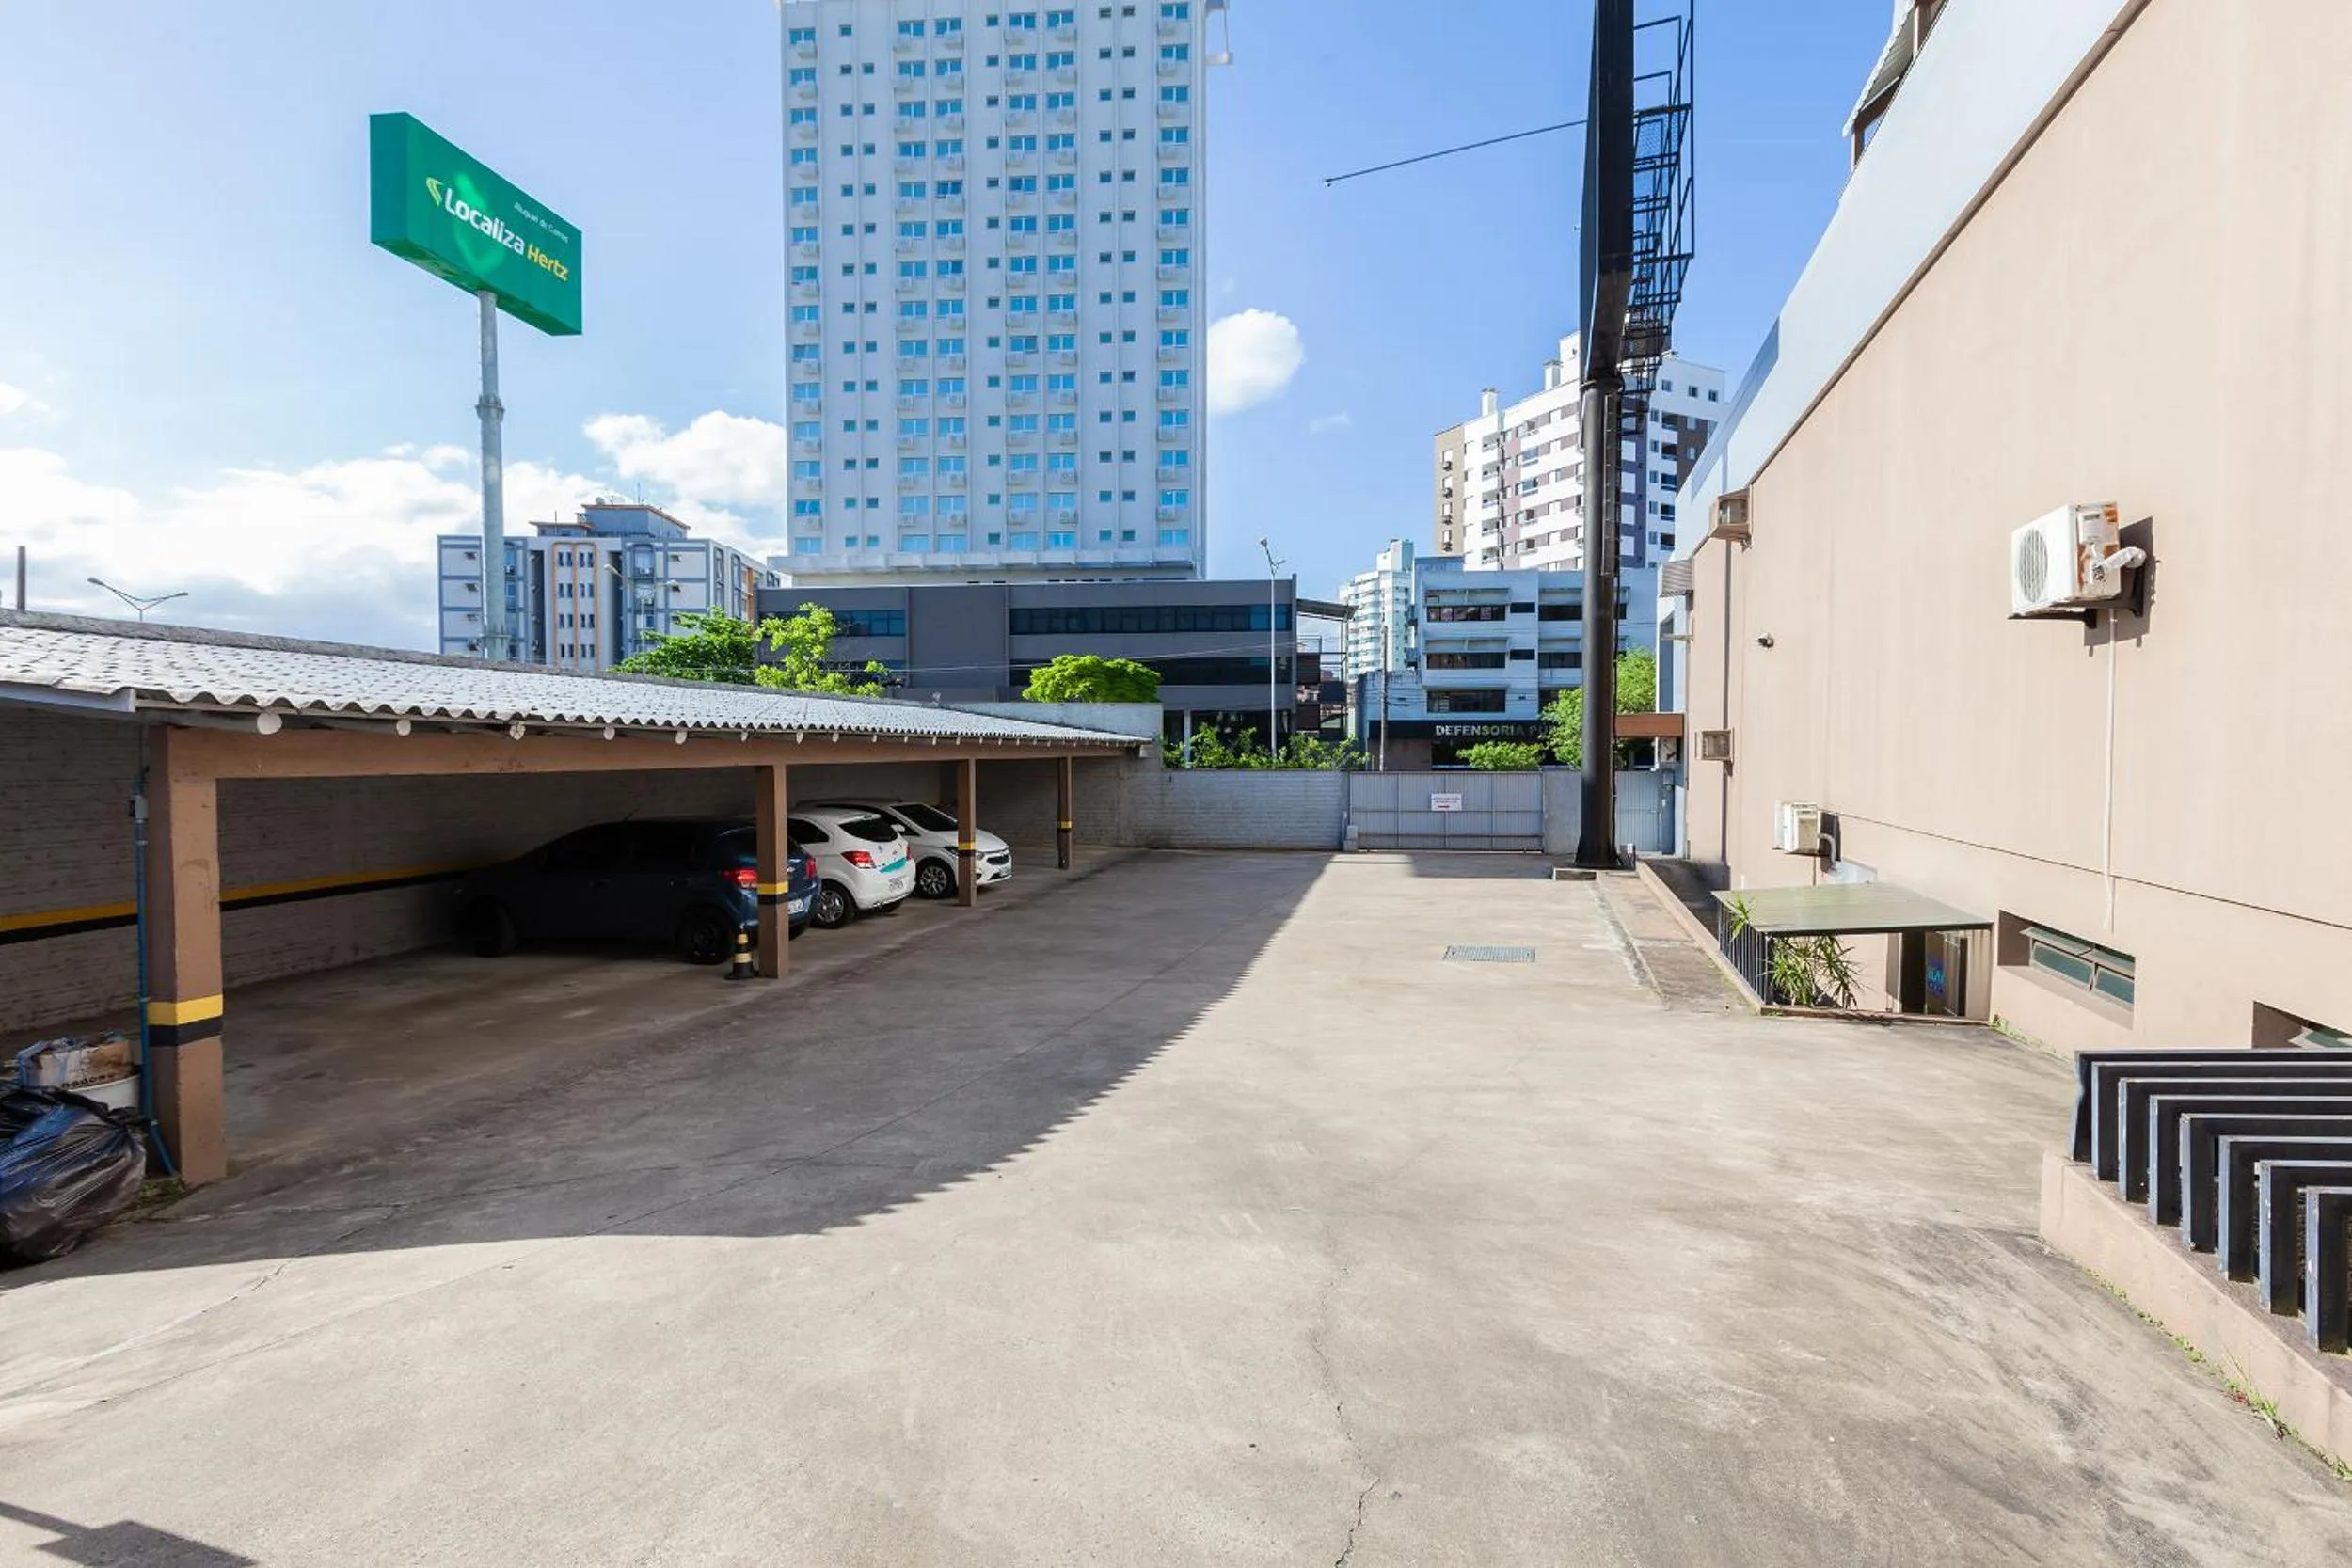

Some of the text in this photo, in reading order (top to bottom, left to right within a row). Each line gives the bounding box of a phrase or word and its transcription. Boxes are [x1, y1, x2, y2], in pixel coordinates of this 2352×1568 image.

[445, 187, 569, 281] Localiza Hertz
[1435, 724, 1524, 736] DEFENSORIA
